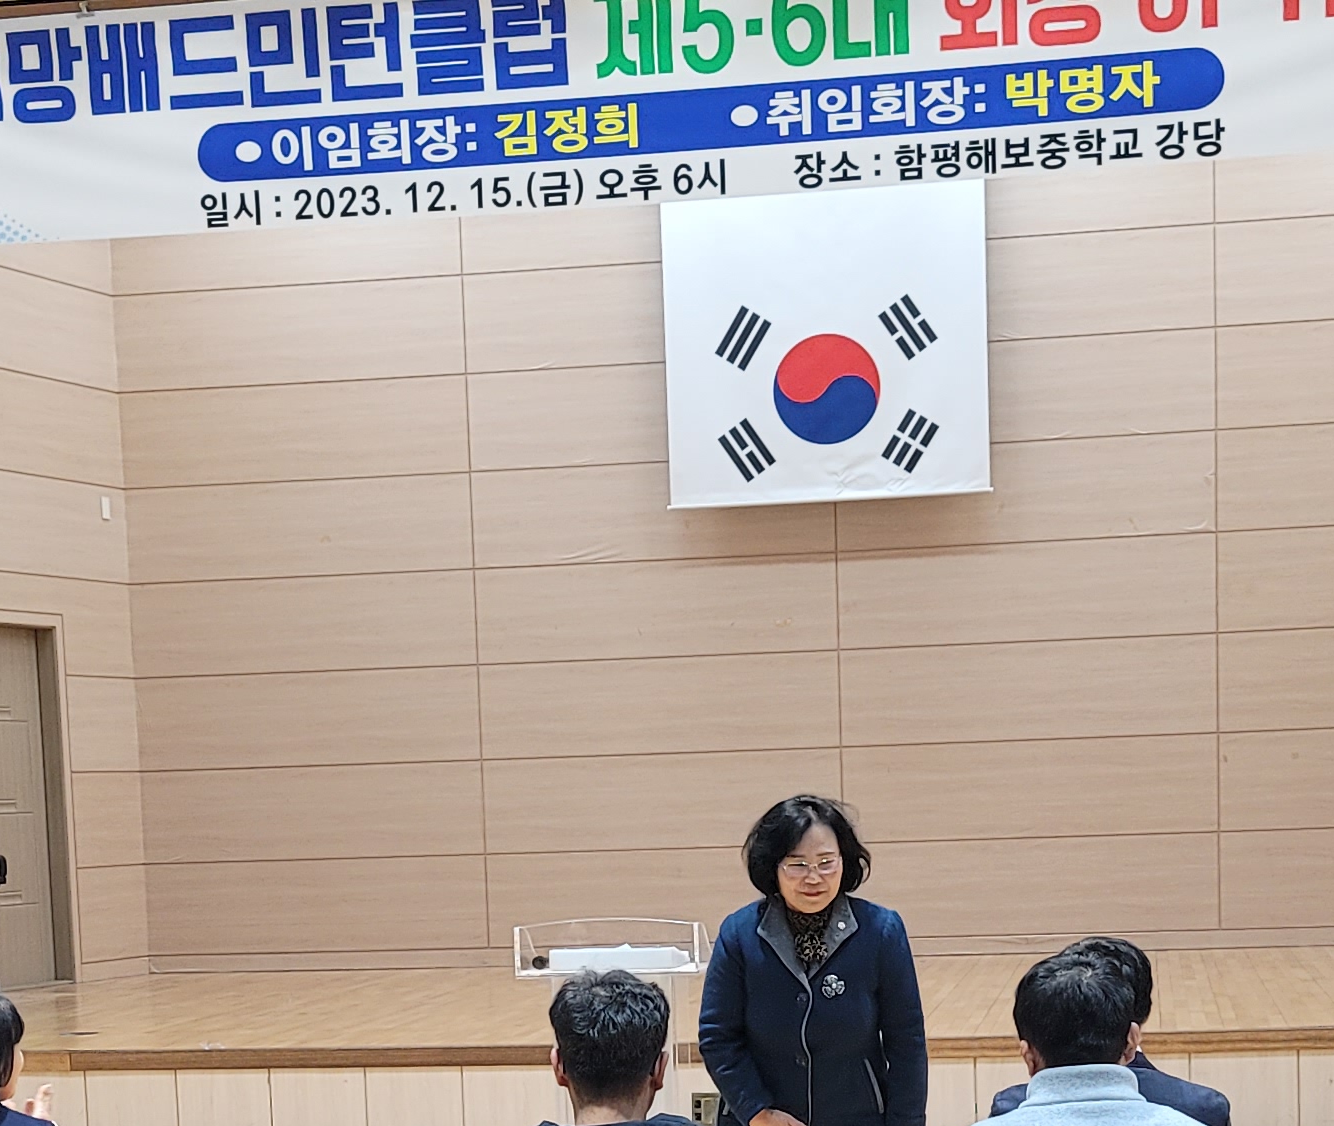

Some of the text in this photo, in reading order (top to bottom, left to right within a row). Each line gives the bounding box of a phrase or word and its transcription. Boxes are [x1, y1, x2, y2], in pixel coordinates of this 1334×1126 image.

[766, 60, 1161, 137] 취임회장: 박명자
[271, 102, 639, 171] 이임회장: 김정희
[894, 127, 1144, 181] 함평해보중학교
[1155, 118, 1226, 161] 강당
[294, 185, 392, 220] 2023.
[596, 163, 662, 200] 오후
[673, 158, 727, 196] 6시
